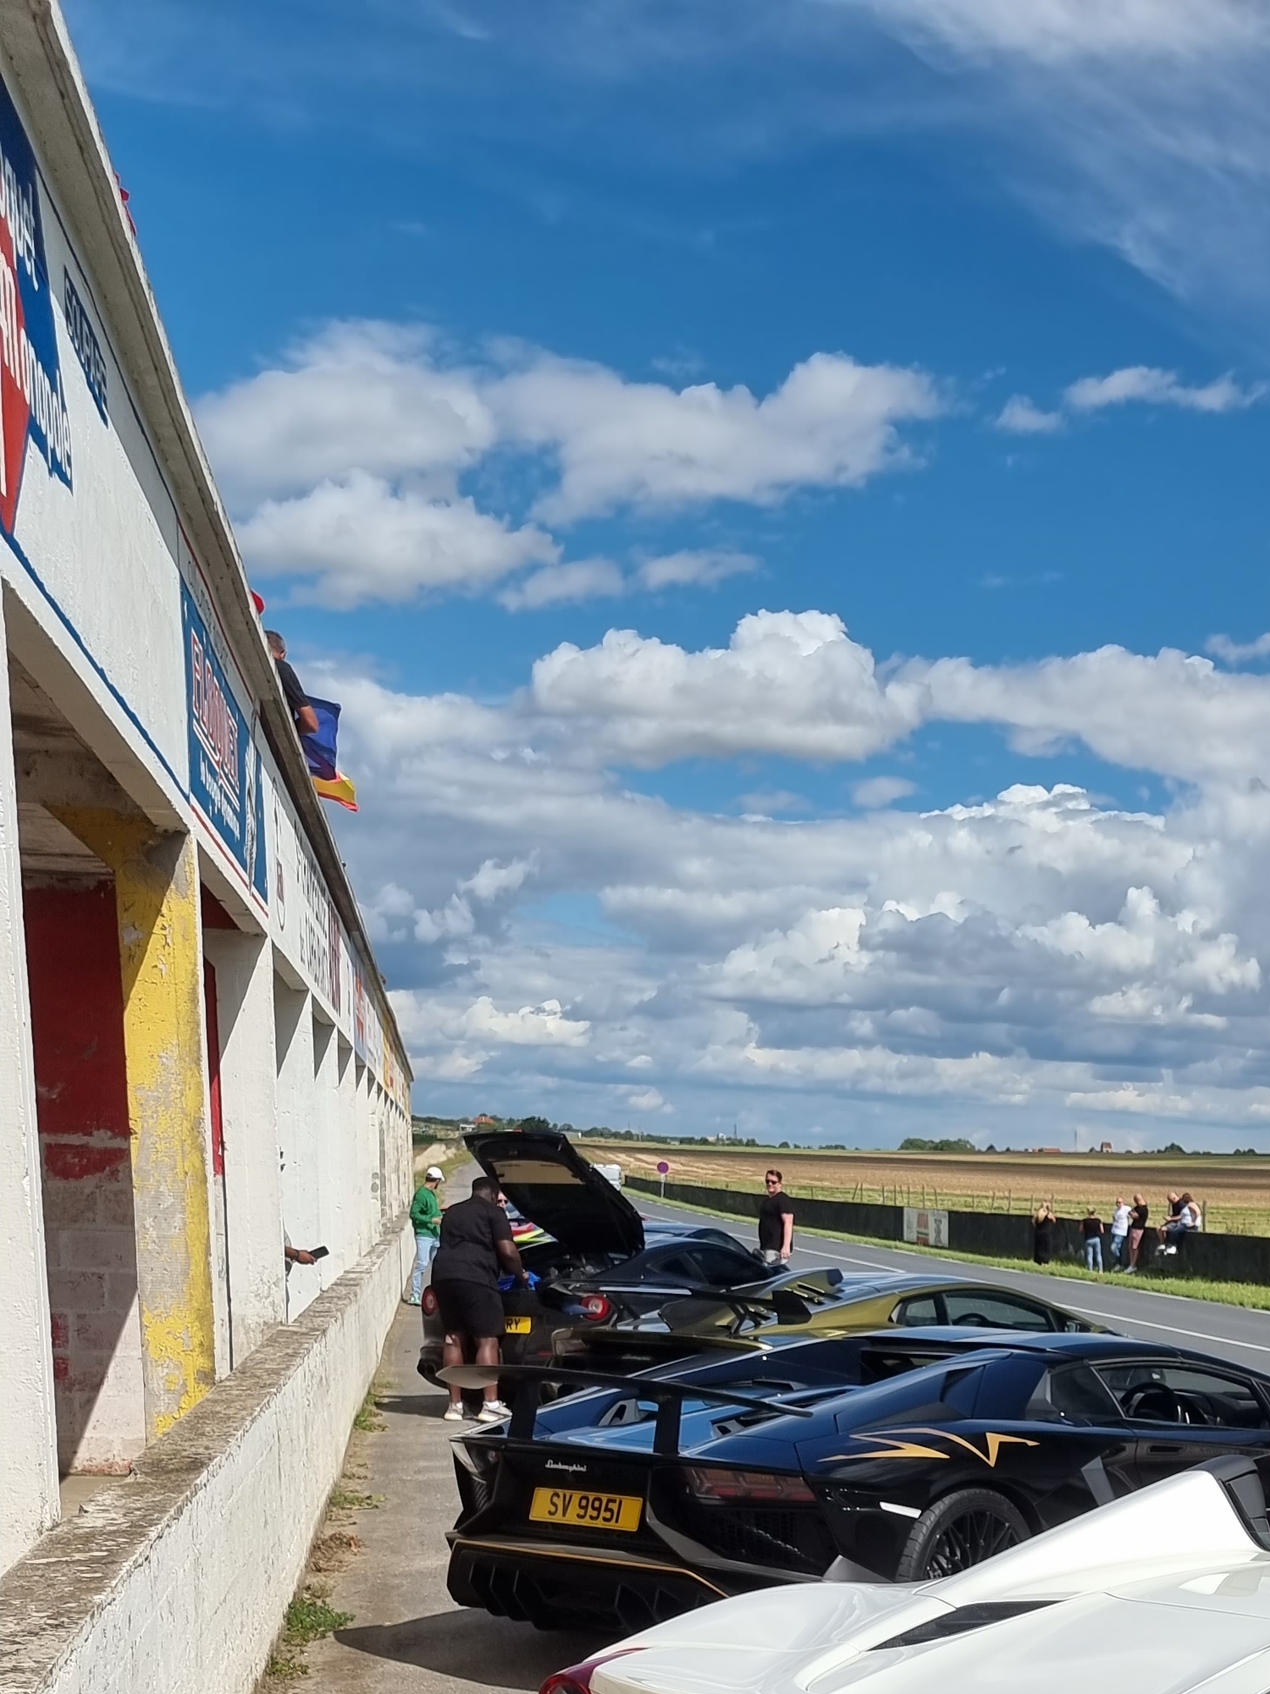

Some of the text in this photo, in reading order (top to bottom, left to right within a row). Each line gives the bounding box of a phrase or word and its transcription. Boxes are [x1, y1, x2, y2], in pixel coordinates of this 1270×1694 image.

[545, 1459, 588, 1473] Lamborghini
[547, 1492, 623, 1524] SV 9951
